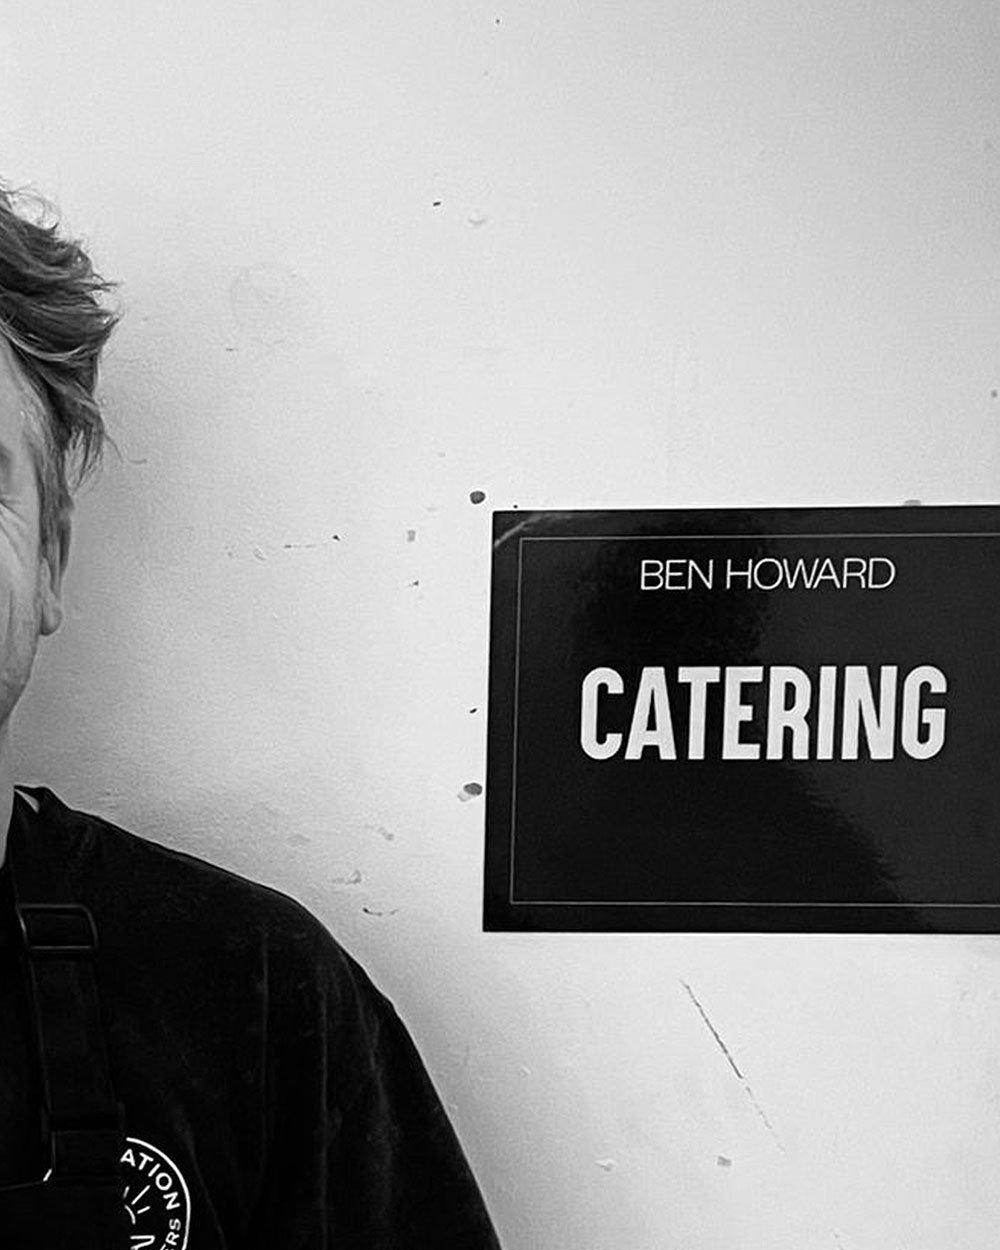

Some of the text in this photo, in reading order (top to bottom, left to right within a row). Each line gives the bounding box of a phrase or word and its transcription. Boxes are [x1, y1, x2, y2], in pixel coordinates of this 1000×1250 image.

[640, 557, 896, 590] BEN HOWARD
[580, 665, 948, 760] CATERING
